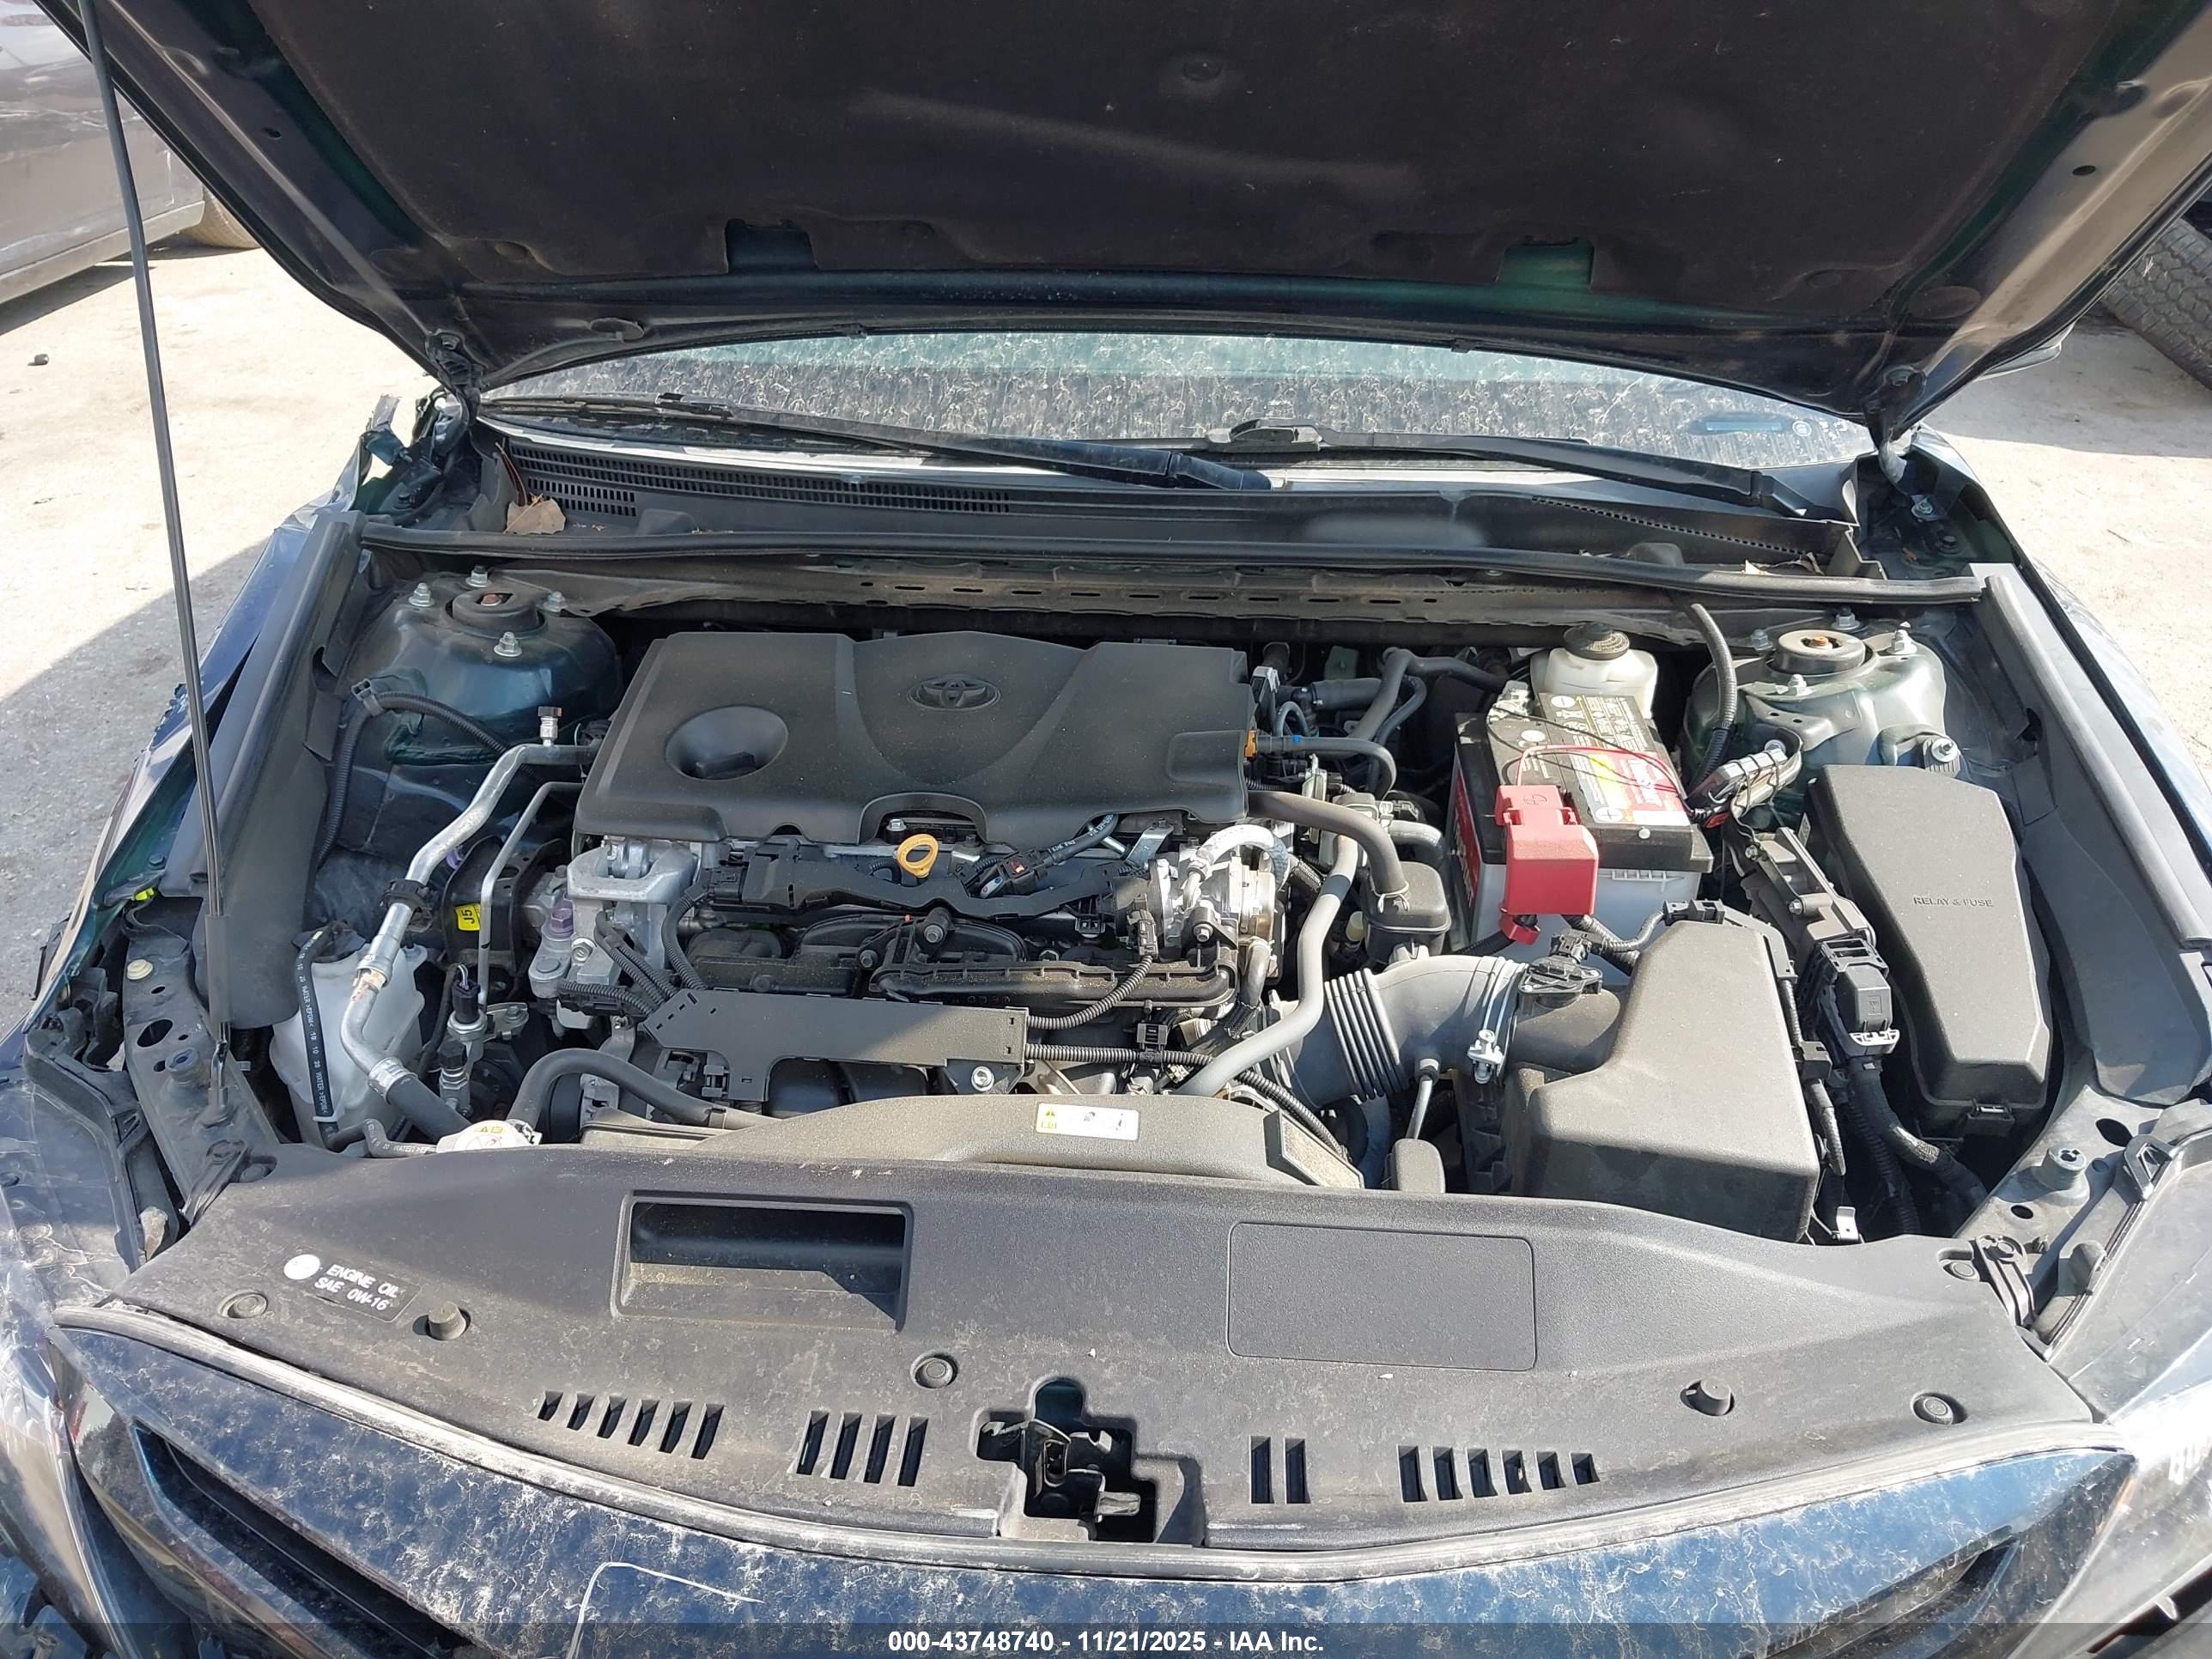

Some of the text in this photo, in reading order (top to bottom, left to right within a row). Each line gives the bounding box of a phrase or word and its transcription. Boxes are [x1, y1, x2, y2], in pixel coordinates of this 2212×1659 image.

[1912, 896, 1950, 907] RELAY
[1963, 898, 1994, 908] FUSE
[314, 1277, 389, 1310] SAE 0W-16
[326, 1264, 399, 1297] ENGINE OIL
